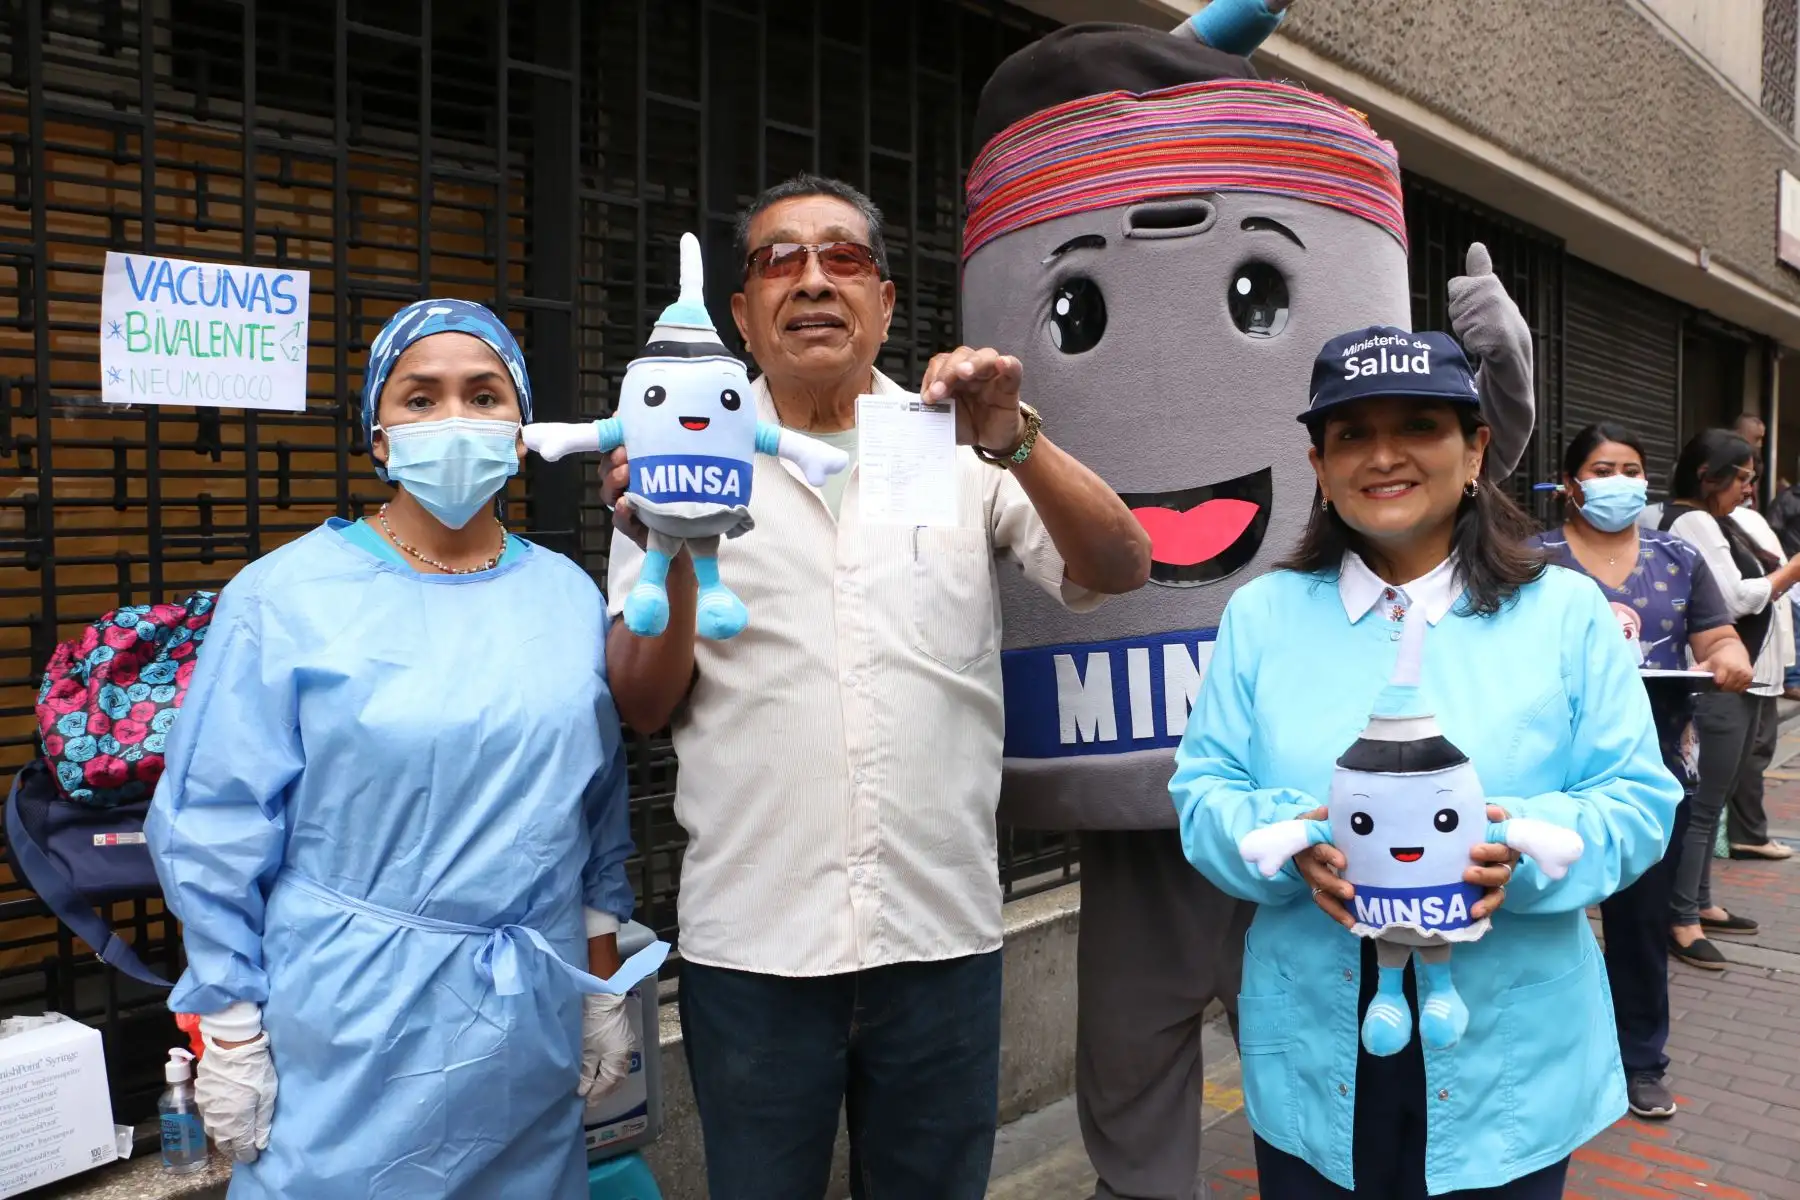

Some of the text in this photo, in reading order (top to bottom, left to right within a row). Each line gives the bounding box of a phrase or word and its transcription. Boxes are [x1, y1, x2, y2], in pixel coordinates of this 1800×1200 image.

[125, 256, 298, 315] VACUNAS
[1342, 334, 1432, 357] Ministerio de
[1344, 347, 1430, 381] Salud
[130, 367, 273, 402] NEUMOCOCO
[640, 464, 740, 498] MINSA
[1354, 893, 1468, 926] MINSA
[45, 1051, 79, 1068] Syringe
